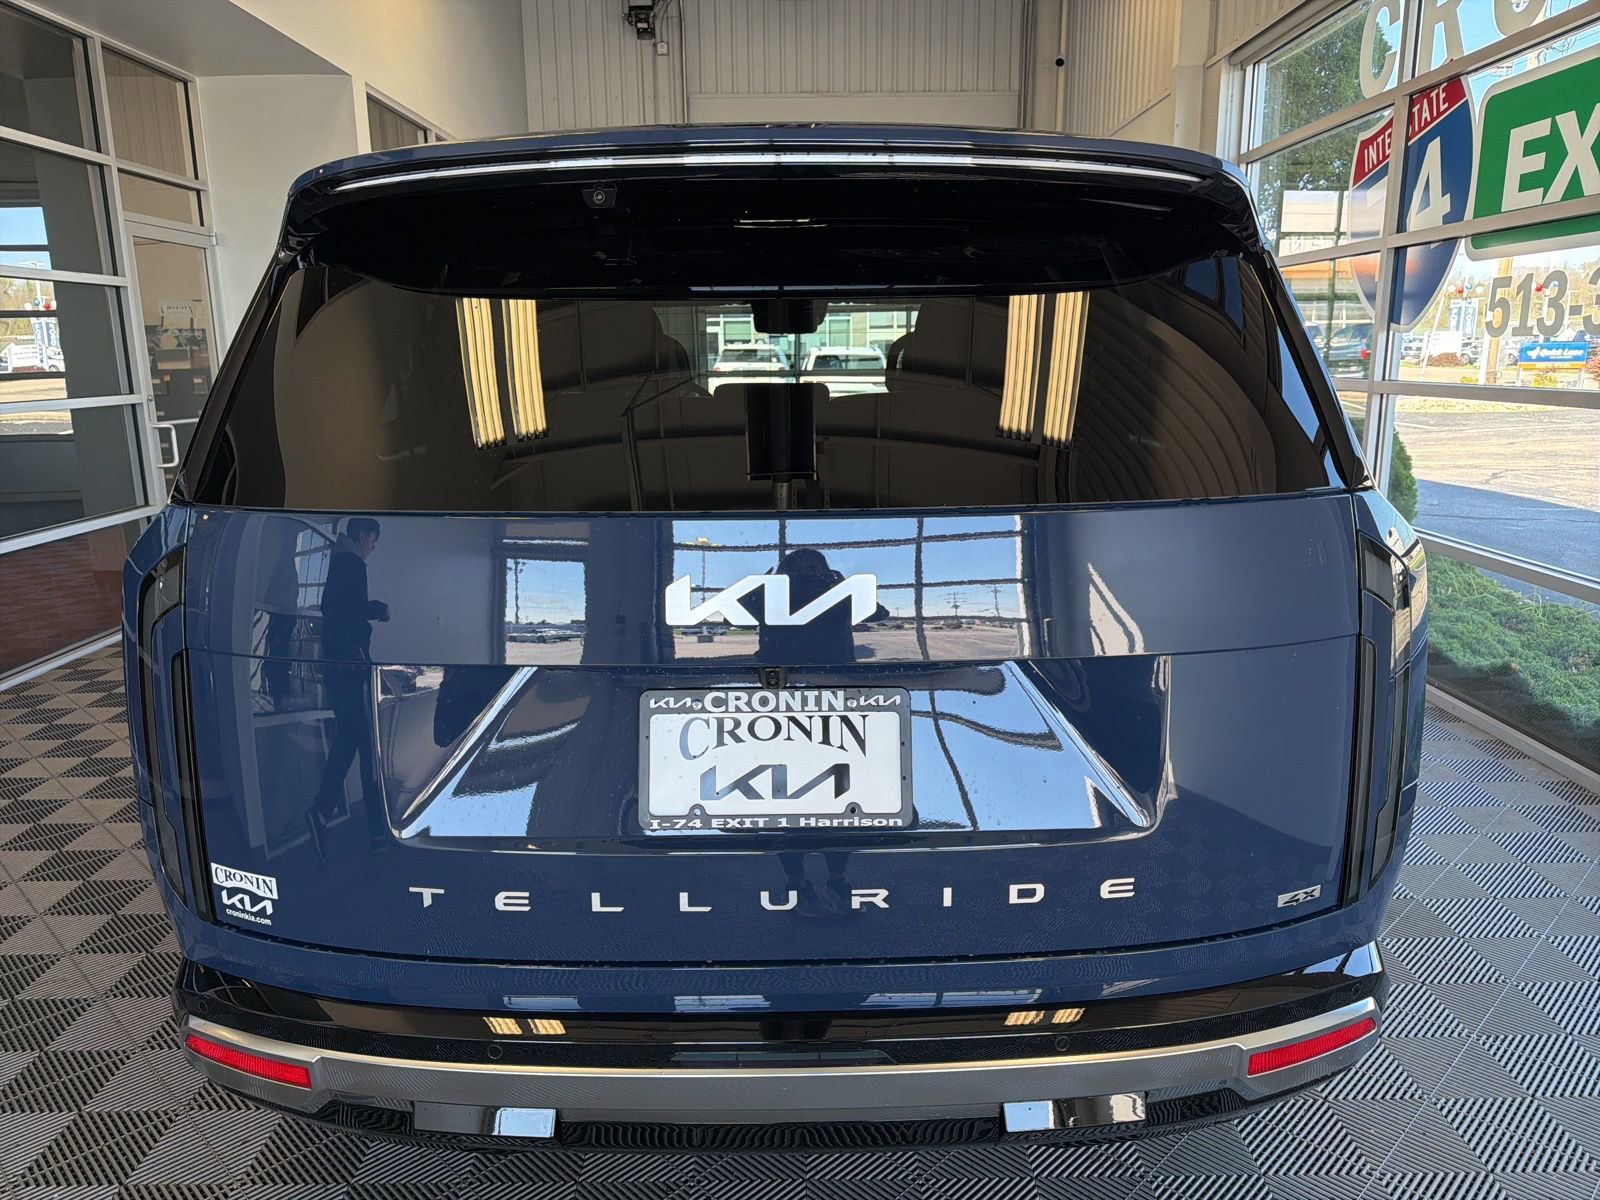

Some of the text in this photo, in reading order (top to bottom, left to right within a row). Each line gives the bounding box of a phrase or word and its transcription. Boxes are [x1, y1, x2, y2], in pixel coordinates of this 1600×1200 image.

[665, 574, 877, 626] KIA
[703, 690, 845, 713] CRONIN
[679, 714, 870, 762] CRONIN
[700, 762, 850, 801] KIA
[650, 816, 903, 829] I-74 EXIT 1 Harrison
[214, 866, 275, 898] CRONIN
[408, 877, 1135, 912] TELLURIDE
[221, 889, 273, 916] KIA
[226, 908, 272, 926] croninkia.com
